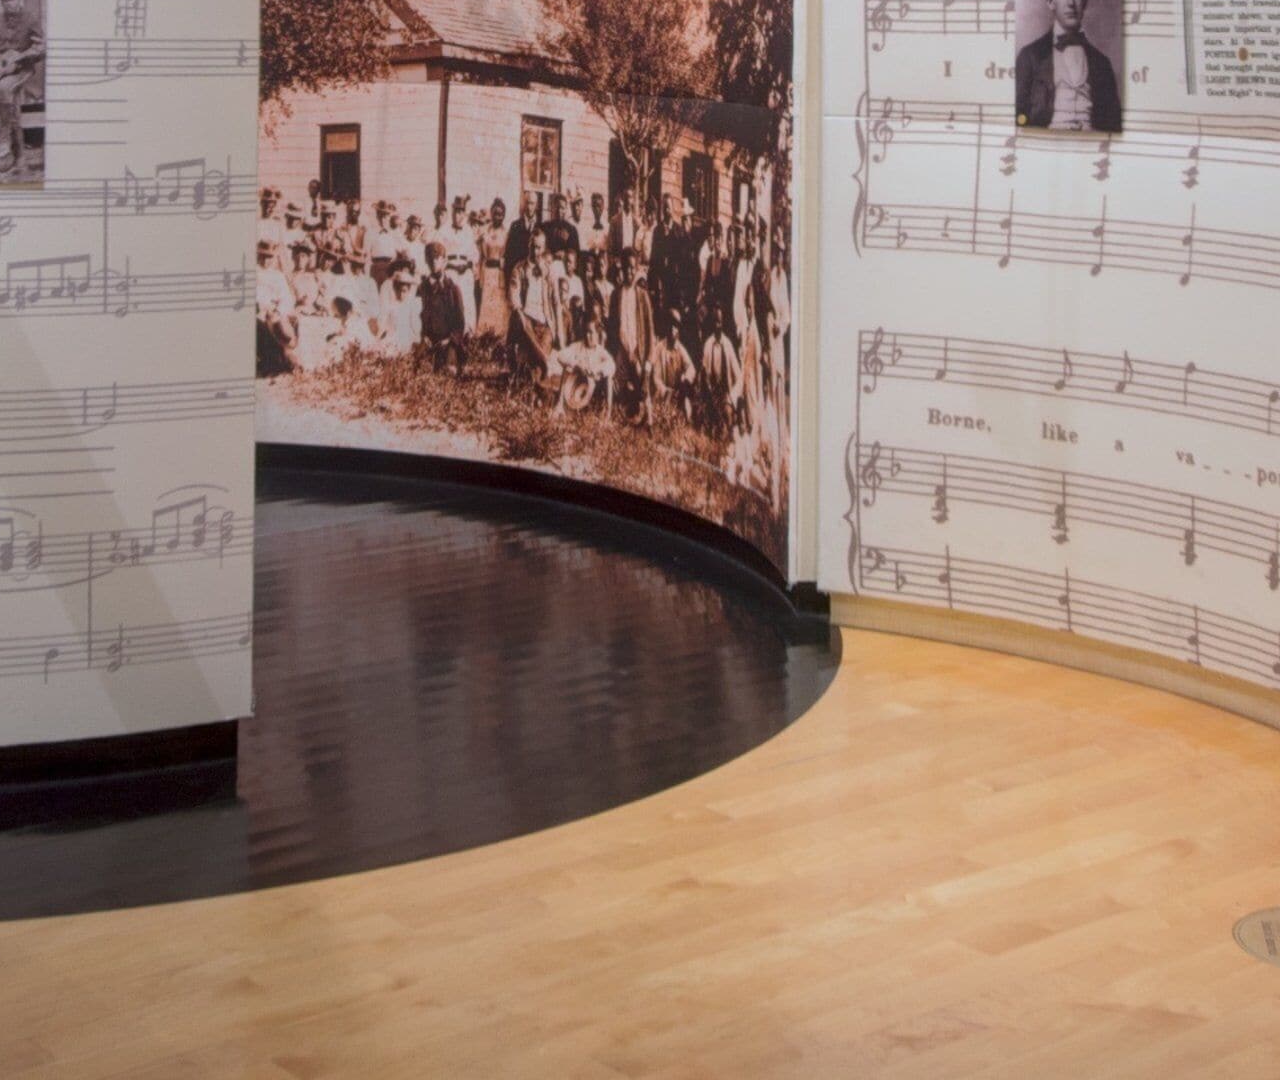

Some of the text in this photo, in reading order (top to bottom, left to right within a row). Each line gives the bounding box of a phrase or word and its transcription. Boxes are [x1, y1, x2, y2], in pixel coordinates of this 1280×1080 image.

[984, 62, 1150, 85] dre of
[927, 407, 993, 433] Borne,
[1042, 422, 1080, 443] like
[1175, 449, 1197, 465] va
